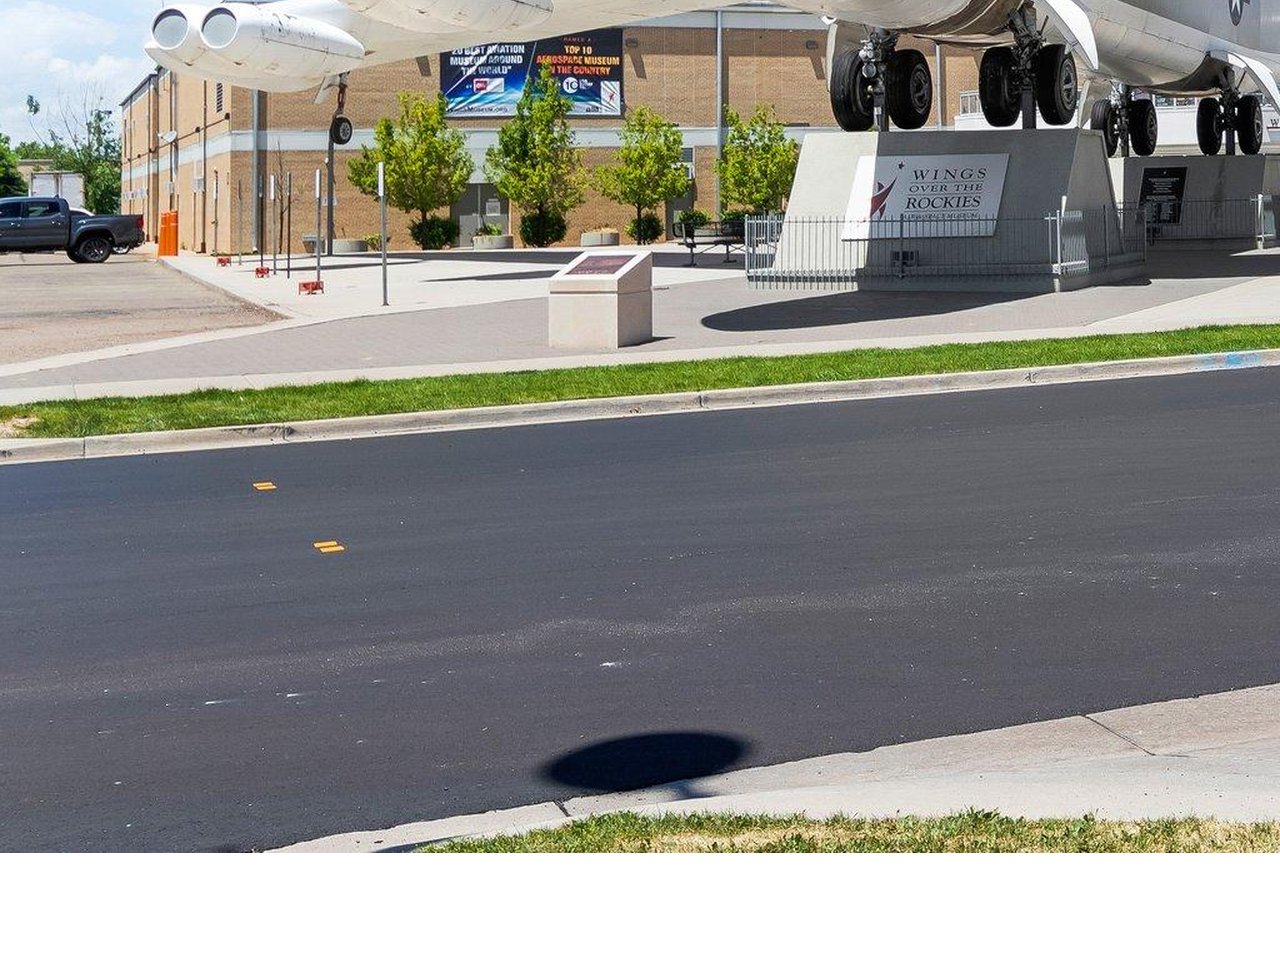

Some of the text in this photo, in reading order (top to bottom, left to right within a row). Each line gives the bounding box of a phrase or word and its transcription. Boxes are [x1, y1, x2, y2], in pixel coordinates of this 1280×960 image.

[564, 45, 593, 55] TOP 10
[536, 55, 620, 66] AEROSPACE MUSEUM
[913, 167, 987, 181] WINGS
[909, 183, 983, 193] OVER THE
[905, 195, 981, 209] ROCKIES
